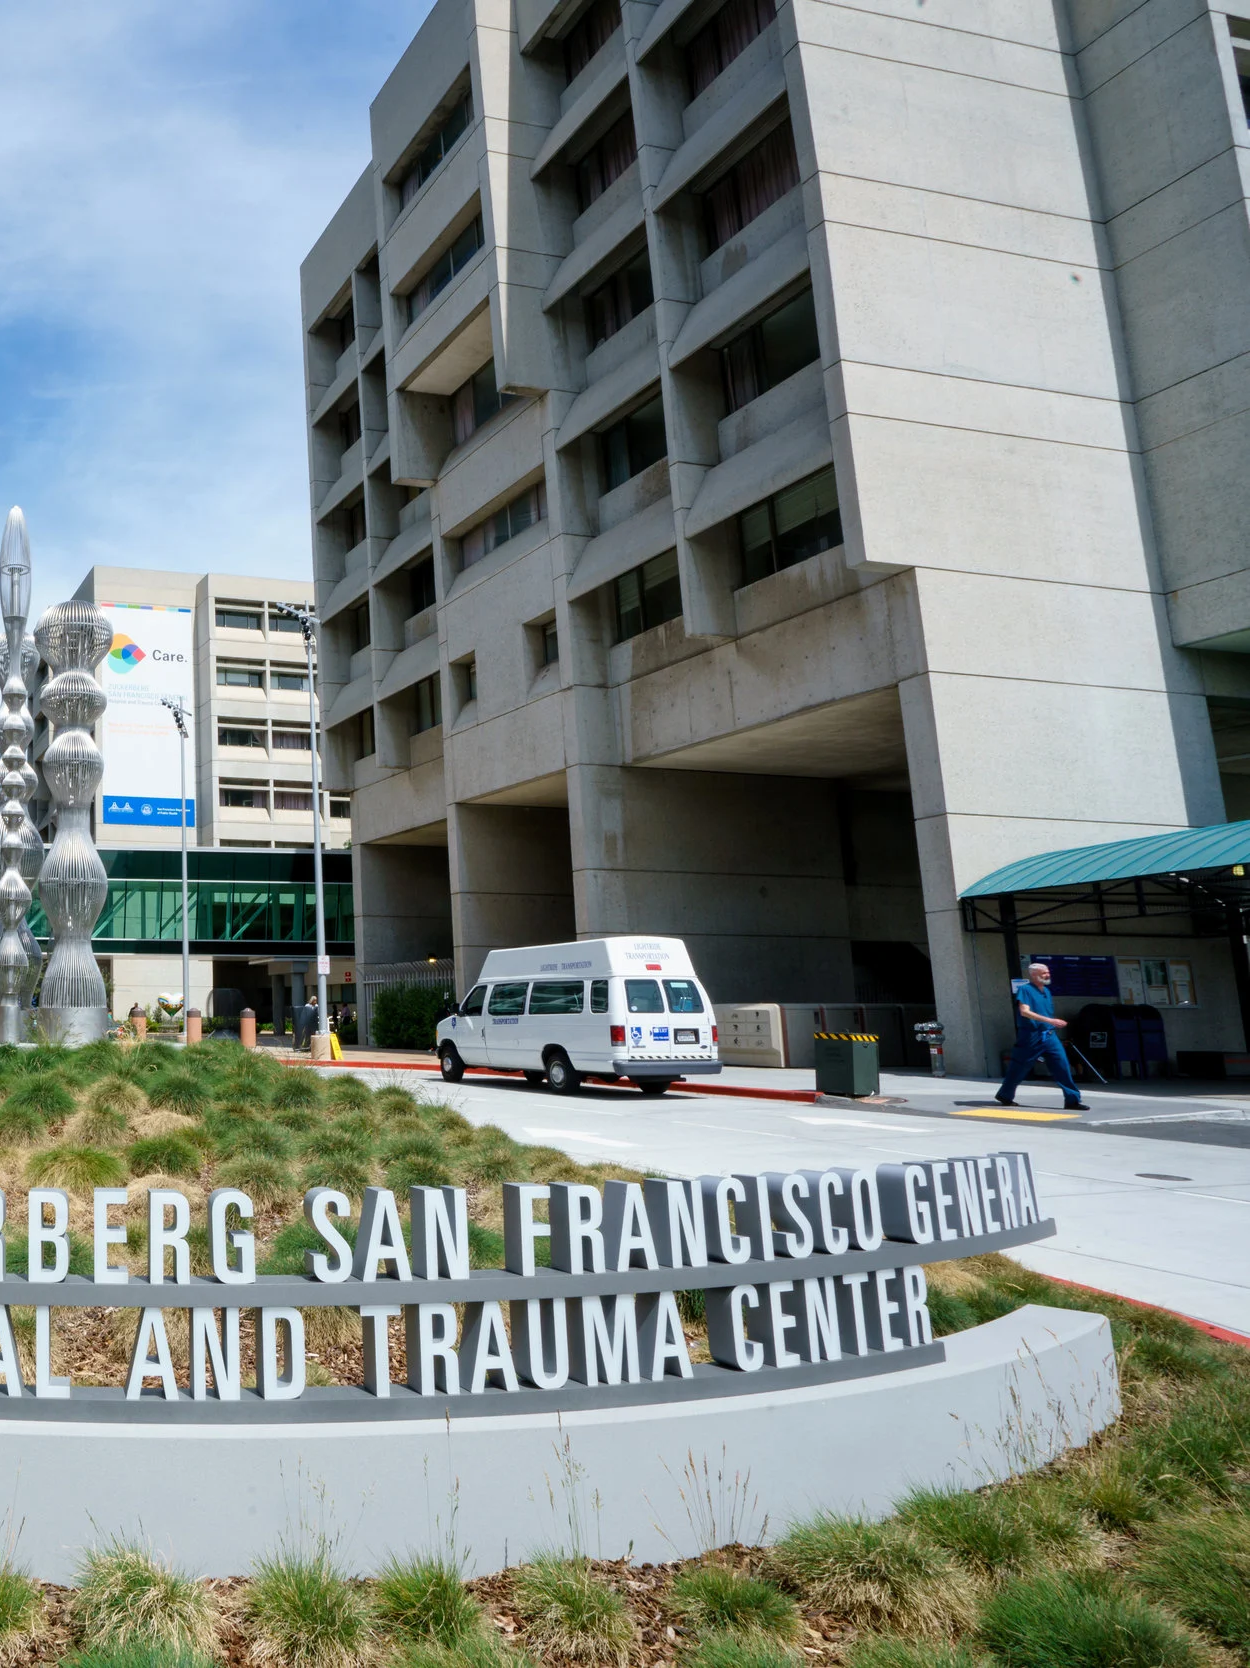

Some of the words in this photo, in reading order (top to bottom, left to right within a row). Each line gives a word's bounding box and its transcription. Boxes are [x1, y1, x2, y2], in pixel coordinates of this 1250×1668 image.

[152, 649, 188, 663] Care.
[303, 1185, 469, 1284] SAN
[503, 1166, 883, 1276] FRANCISCO
[124, 1306, 306, 1401] AND
[359, 1291, 695, 1398] TRAUMA
[716, 1265, 934, 1373] CENTER
